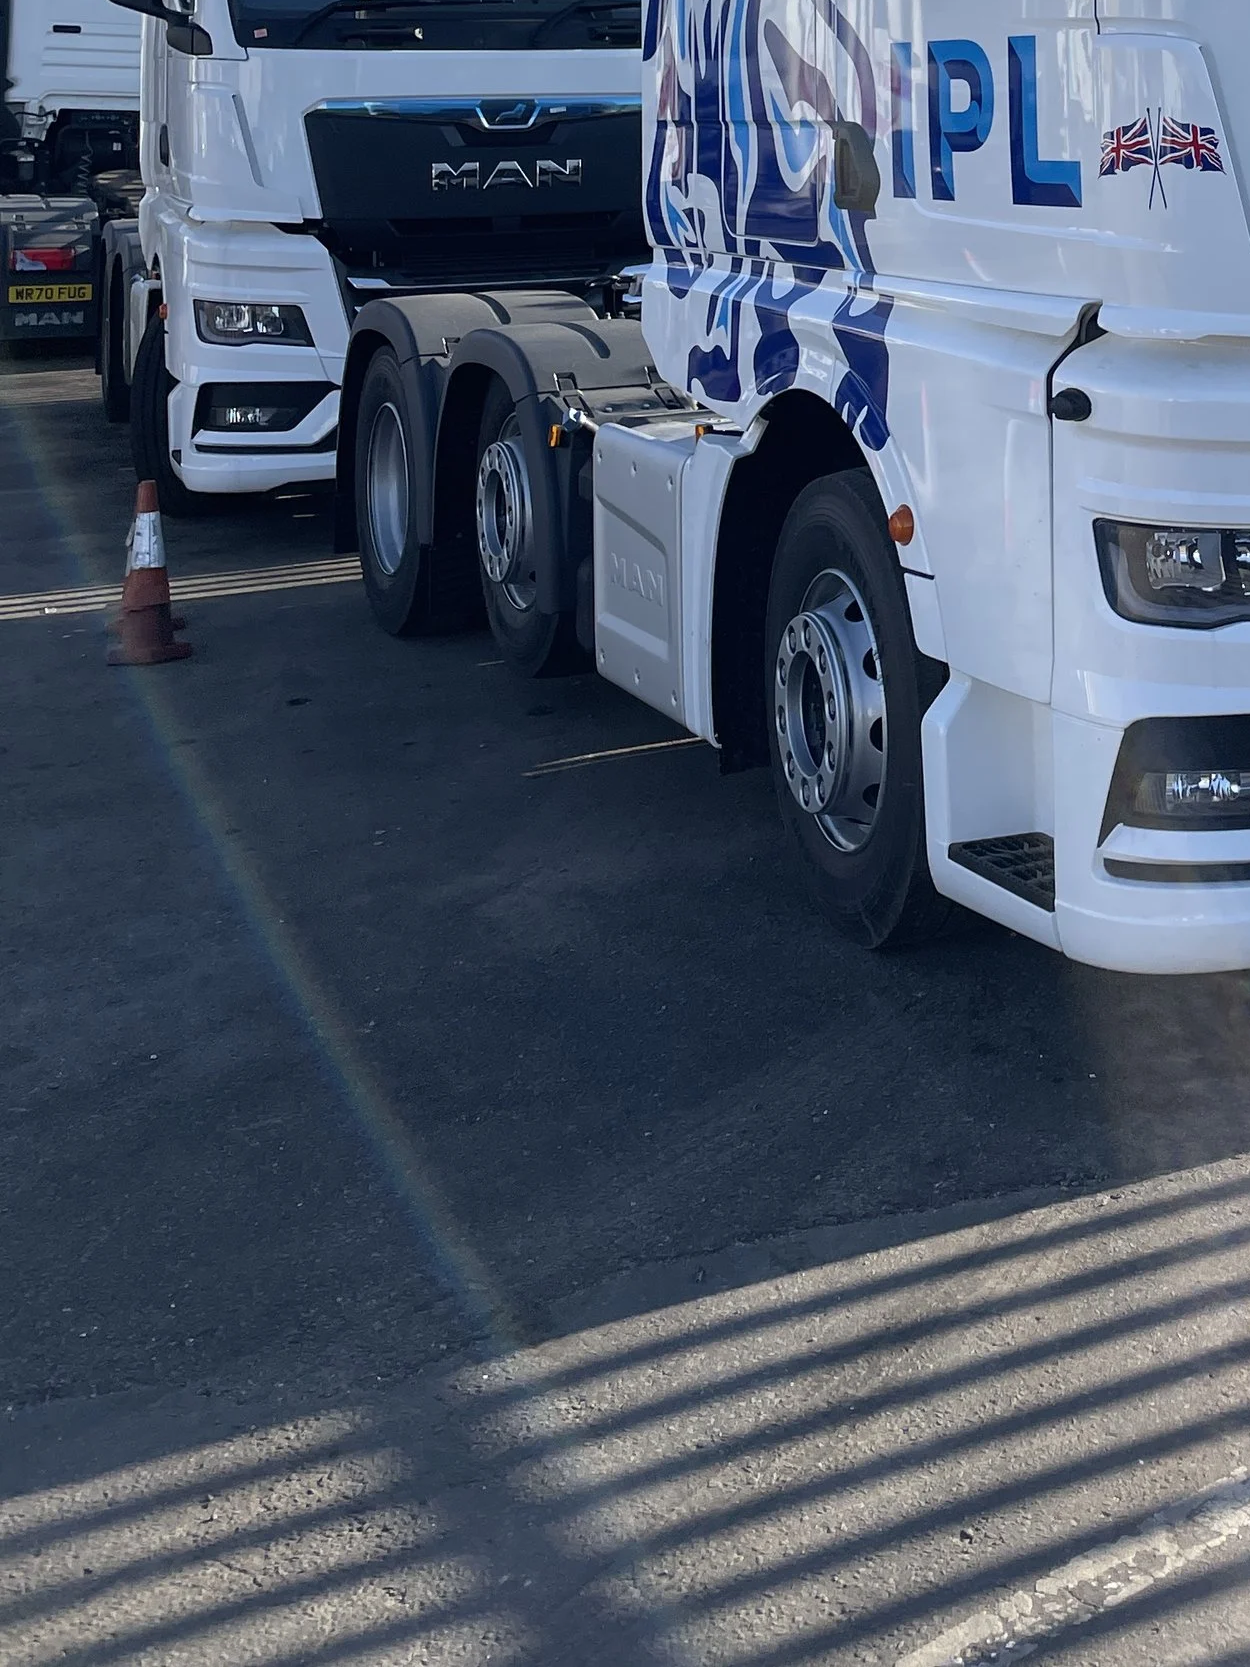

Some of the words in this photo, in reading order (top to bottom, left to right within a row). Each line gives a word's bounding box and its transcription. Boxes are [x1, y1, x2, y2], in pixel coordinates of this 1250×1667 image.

[890, 35, 1082, 208] IPL
[432, 159, 582, 190] MAN
[15, 287, 54, 300] WR70
[58, 286, 87, 299] FUG
[15, 311, 84, 327] MAN
[610, 551, 664, 607] MAN
